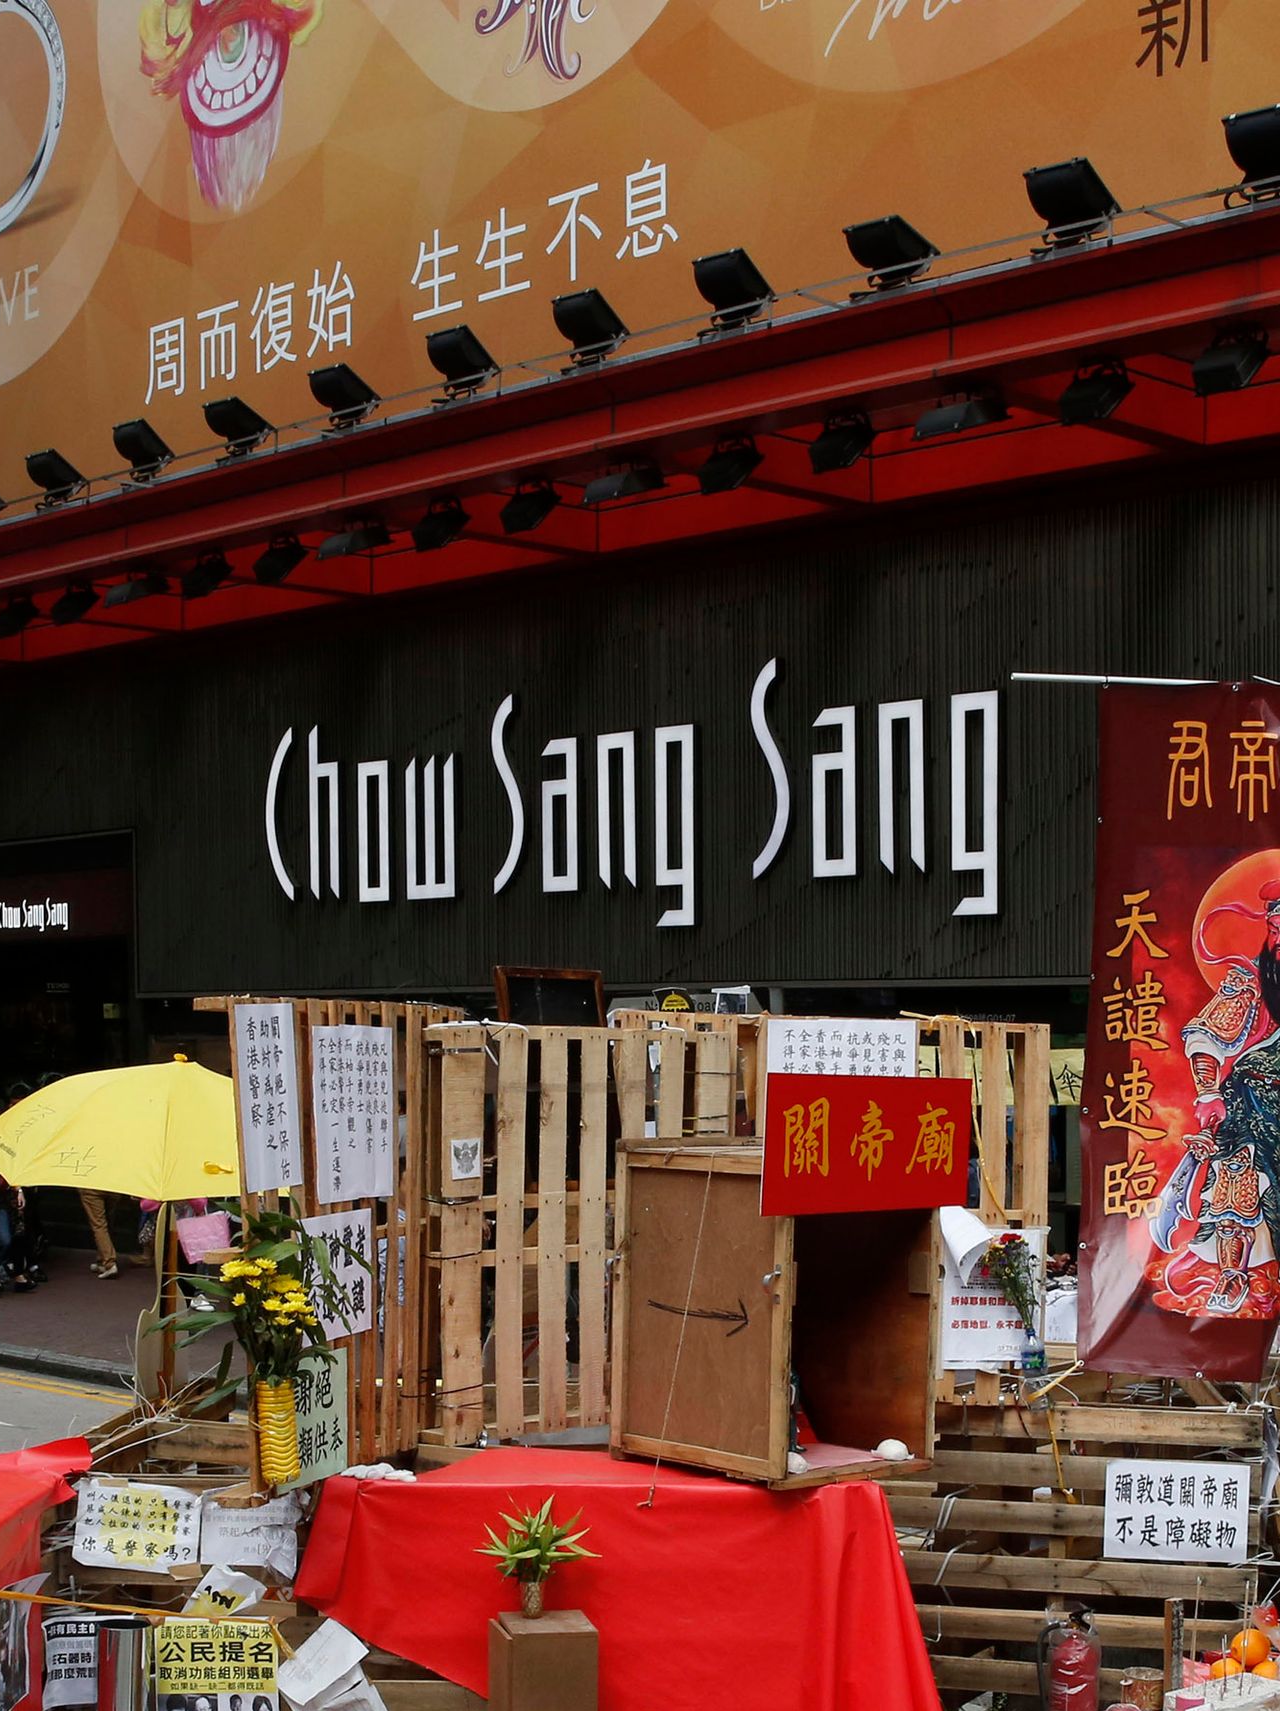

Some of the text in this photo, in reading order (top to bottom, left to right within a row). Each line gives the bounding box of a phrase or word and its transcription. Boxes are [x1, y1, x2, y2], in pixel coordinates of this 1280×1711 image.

[144, 157, 680, 404] 周而復始 生生不息
[266, 656, 1000, 927] Chow Sang Sang
[22, 900, 44, 932] Sang
[46, 897, 68, 930] Sang
[783, 1097, 956, 1181] 關帝廟
[1114, 1475, 1239, 1512] 彌敦道關帝廟
[1115, 1515, 1238, 1550] 不是障礙物
[159, 1642, 274, 1663] 公民提名
[159, 1666, 274, 1680] 取消功能組別選舉
